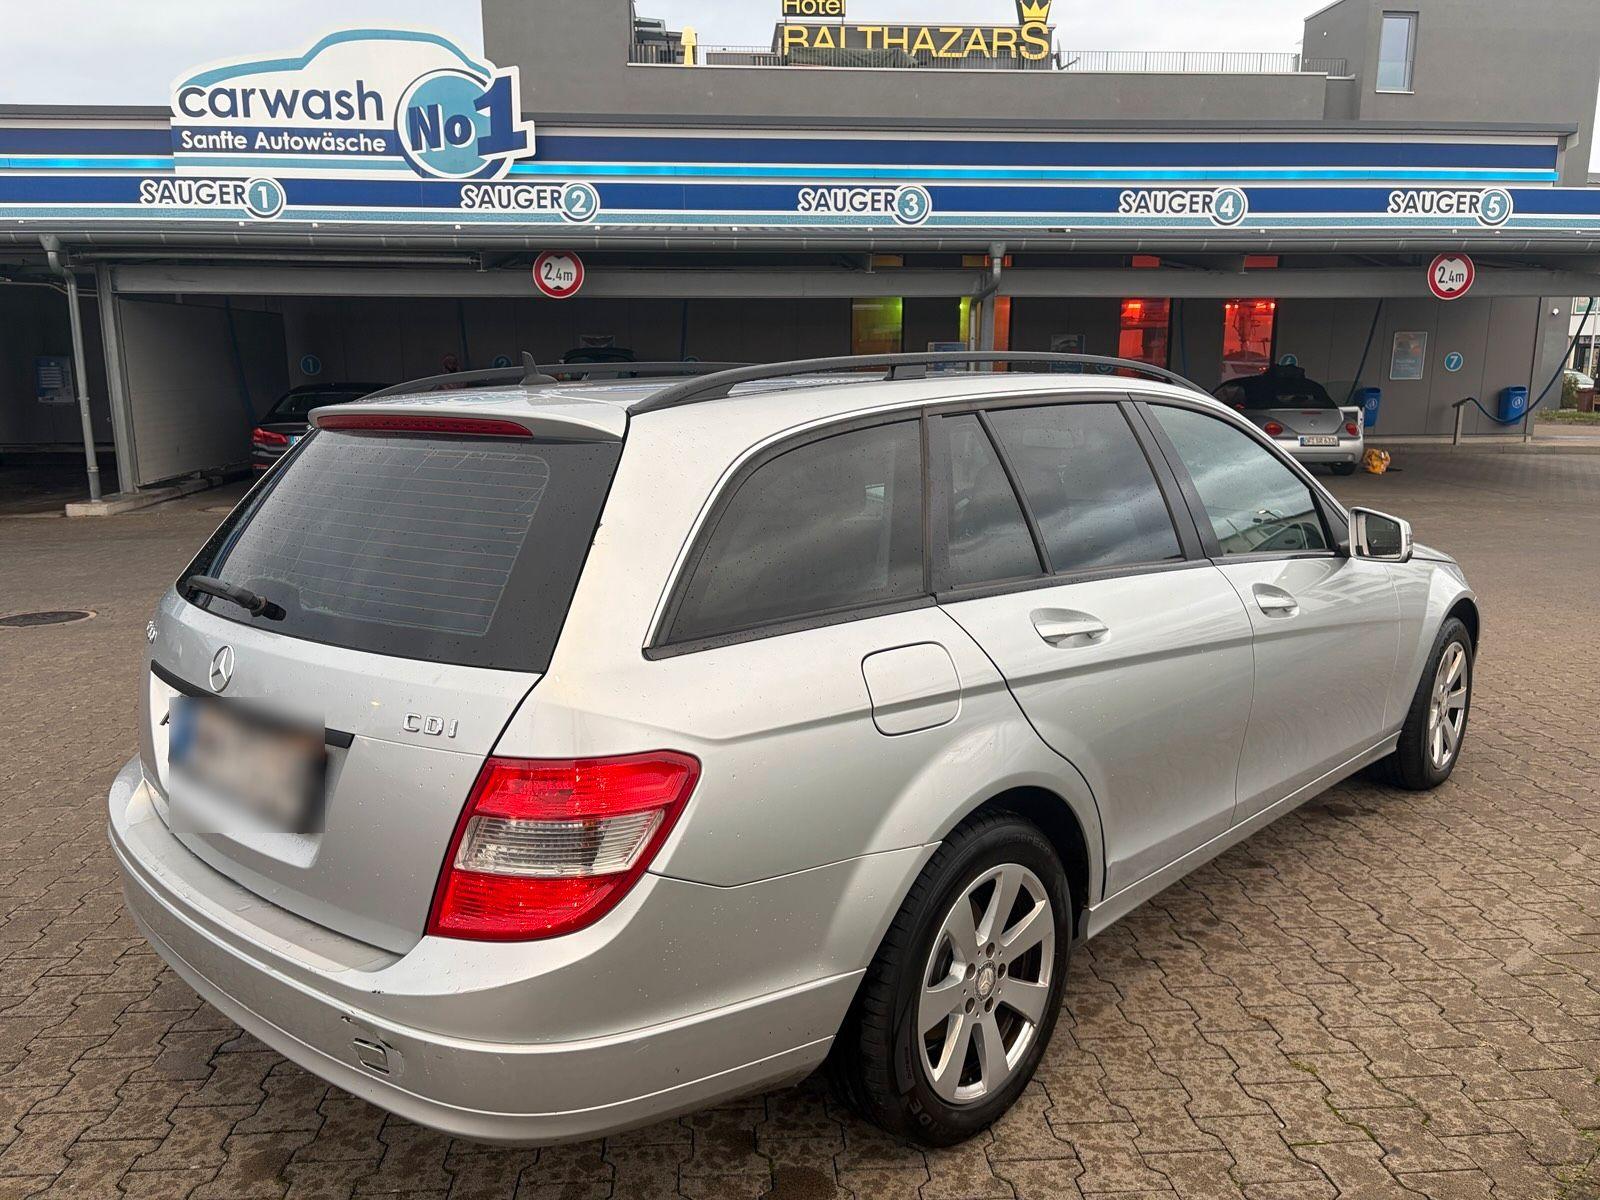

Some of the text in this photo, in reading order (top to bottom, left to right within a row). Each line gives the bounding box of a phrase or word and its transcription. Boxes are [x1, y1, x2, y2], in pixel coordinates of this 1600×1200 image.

[783, 0, 845, 15] Hotel
[178, 79, 384, 121] carwash
[181, 130, 387, 152] Sanfte Autowäsche
[143, 182, 269, 209] SAUGER 1
[464, 187, 587, 213] SAUGER 2
[800, 191, 919, 216] SAUGER 3
[1121, 193, 1235, 217] SAUGER 4
[1390, 193, 1501, 218] SAUGER 5
[403, 712, 458, 738] CDI
